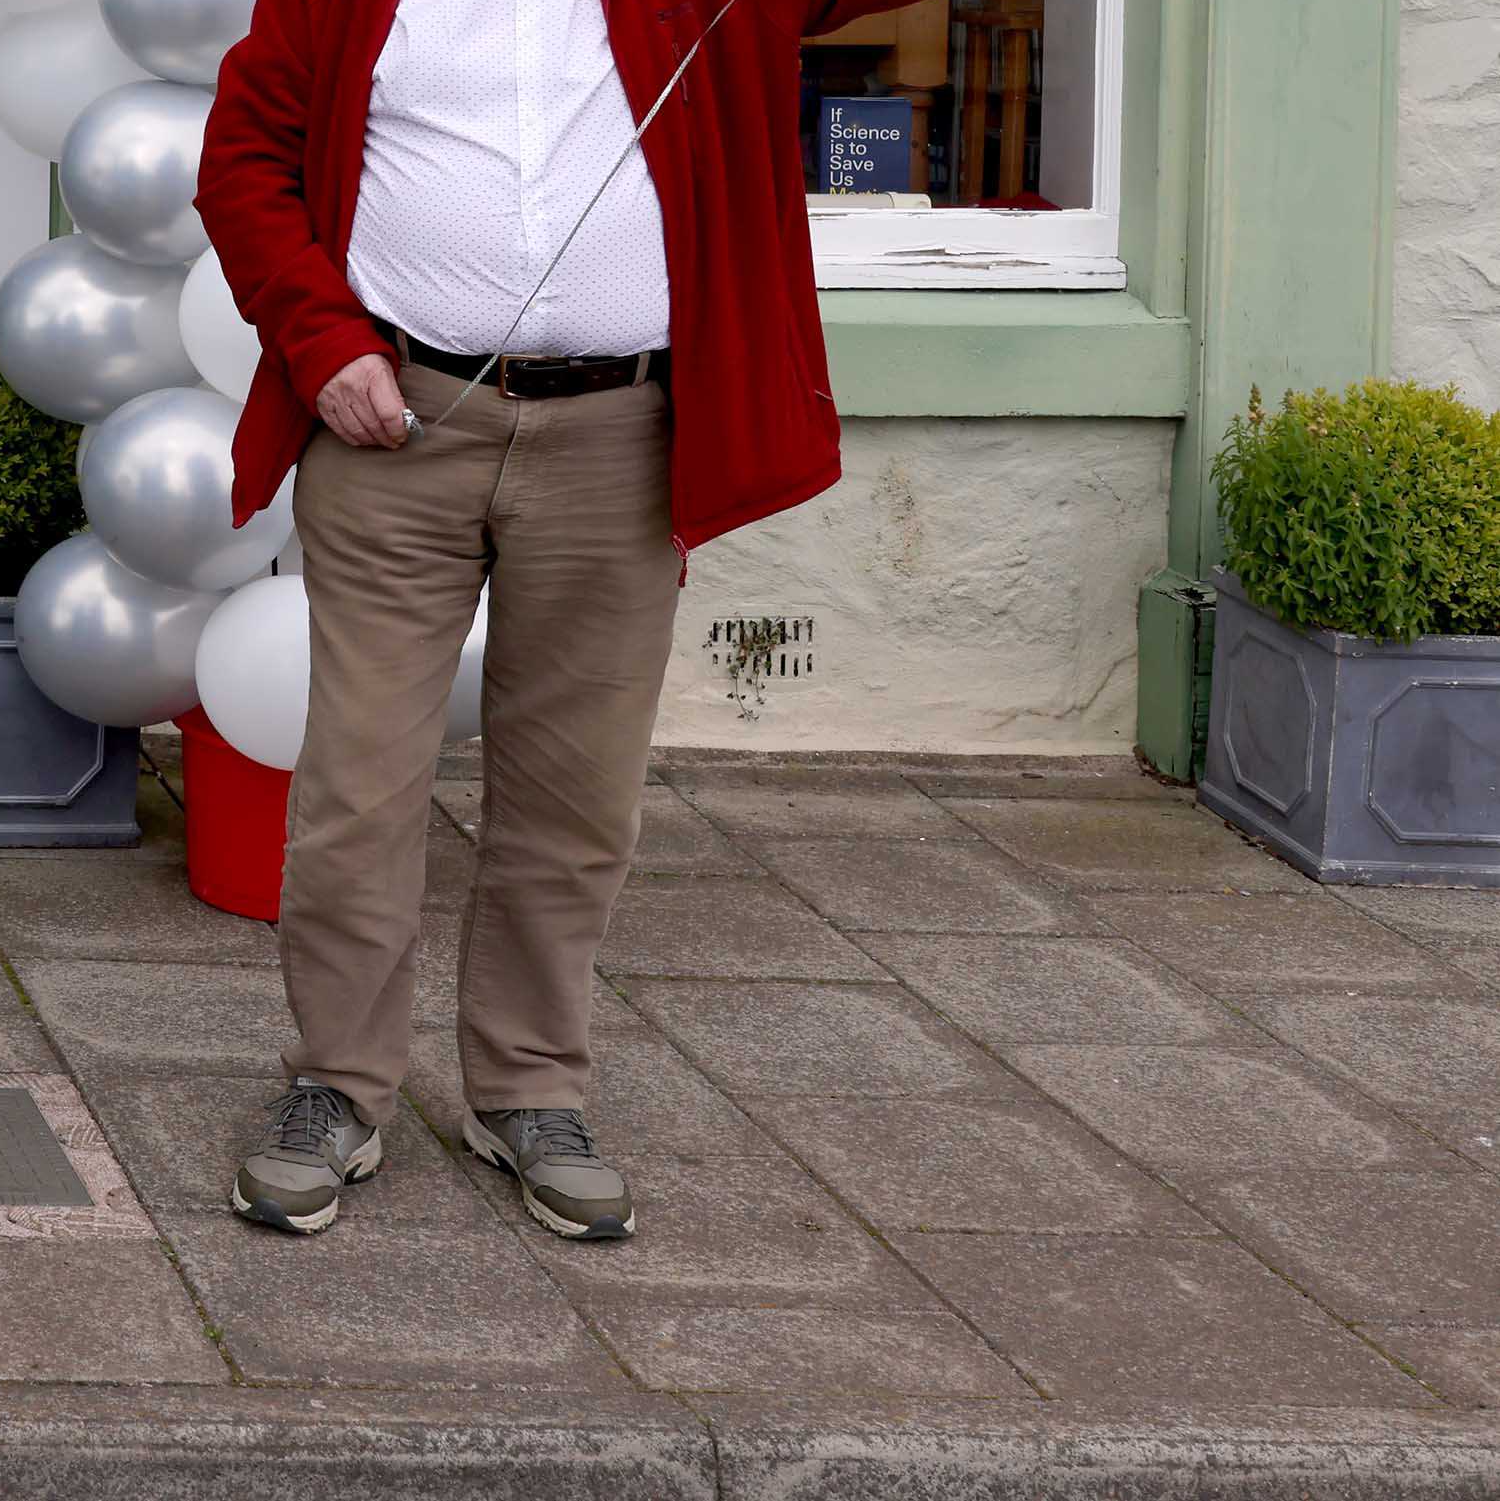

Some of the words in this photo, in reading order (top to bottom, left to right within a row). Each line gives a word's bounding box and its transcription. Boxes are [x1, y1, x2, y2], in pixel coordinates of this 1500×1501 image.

[831, 107, 843, 122] If
[830, 123, 900, 141] Science
[830, 140, 844, 155] is
[849, 141, 867, 156] to
[829, 155, 874, 172] Save
[829, 171, 854, 187] Us
